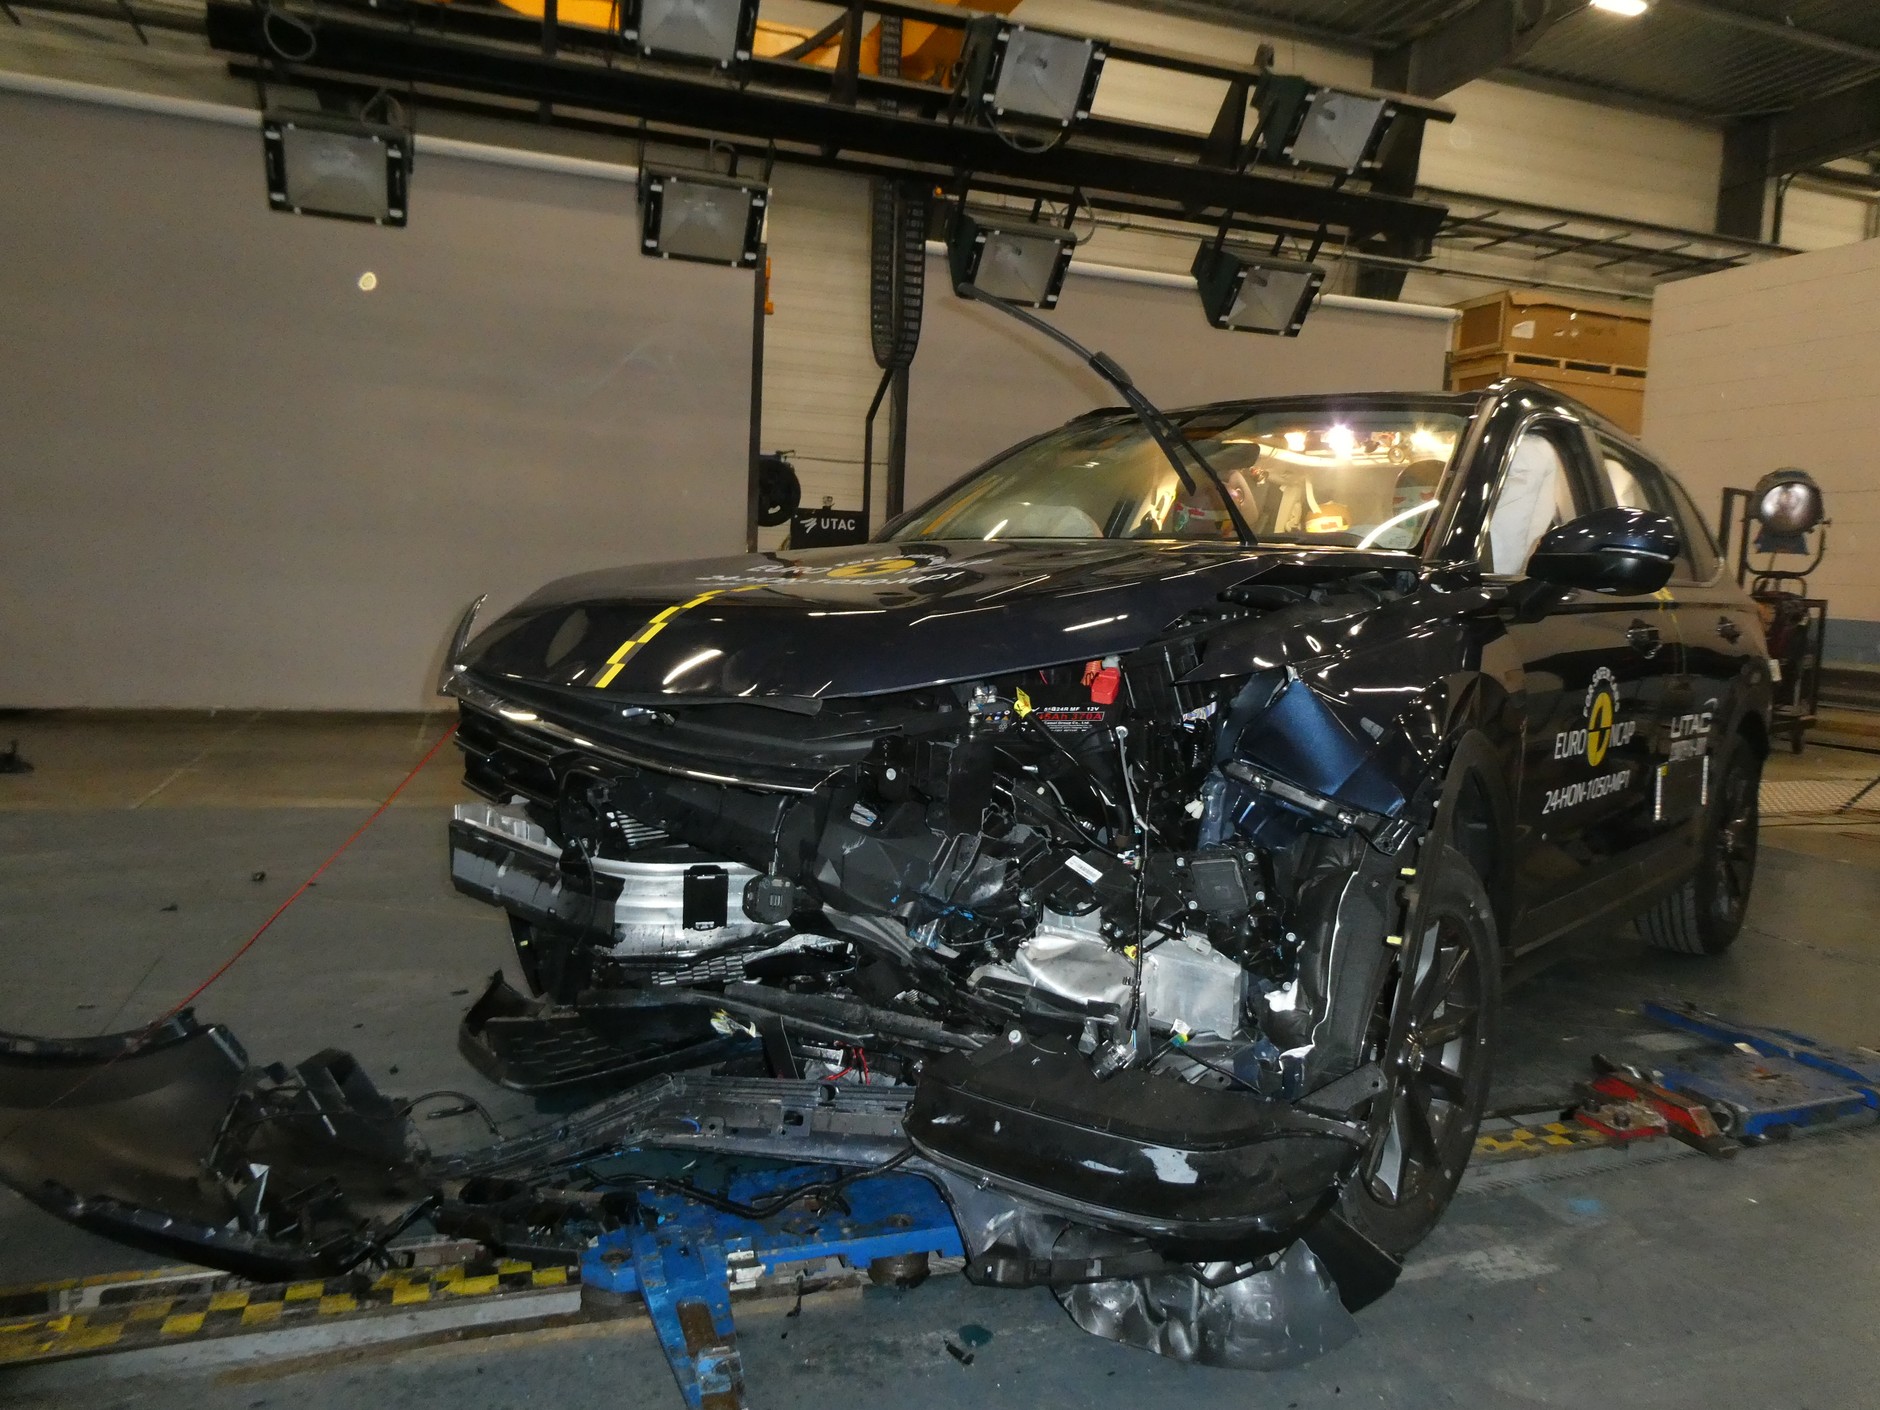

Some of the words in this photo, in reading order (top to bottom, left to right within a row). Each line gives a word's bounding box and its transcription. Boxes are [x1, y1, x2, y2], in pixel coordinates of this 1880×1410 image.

[821, 518, 856, 531] UTAC
[1554, 728, 1587, 759] EURO
[1609, 721, 1636, 748] NCAP
